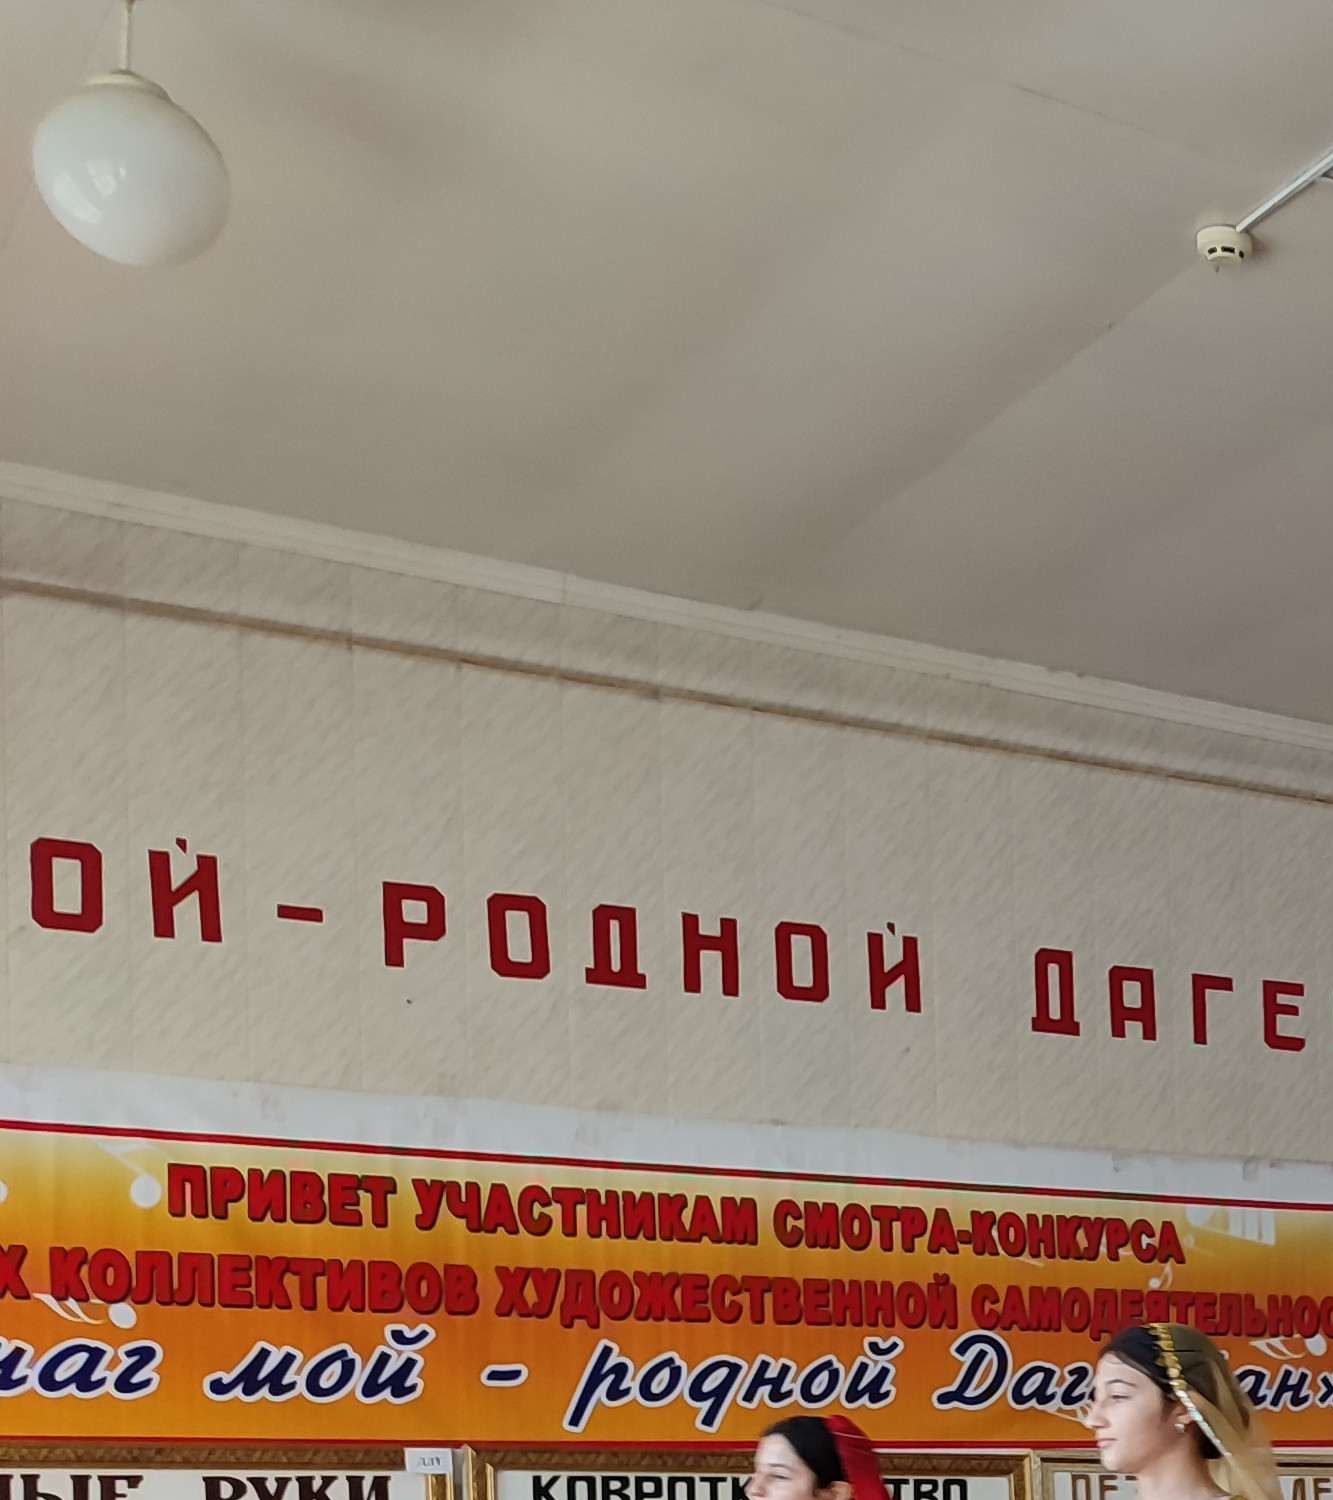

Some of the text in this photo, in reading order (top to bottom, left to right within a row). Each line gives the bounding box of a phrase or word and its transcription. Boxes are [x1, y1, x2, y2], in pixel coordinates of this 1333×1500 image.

[382, 881, 922, 1013] РОДНОЙ
[168, 1163, 1186, 1264] ПРИВЕТ УЧАСТНИКАМ СМОТРА-КОНКУРСА
[48, 1246, 479, 1317] КОЛЛЕКТИВОВ
[494, 1266, 959, 1329] ХУДОЖЕСТВЕННОЙ
[205, 1326, 433, 1402] мой
[565, 1341, 901, 1430] родной
